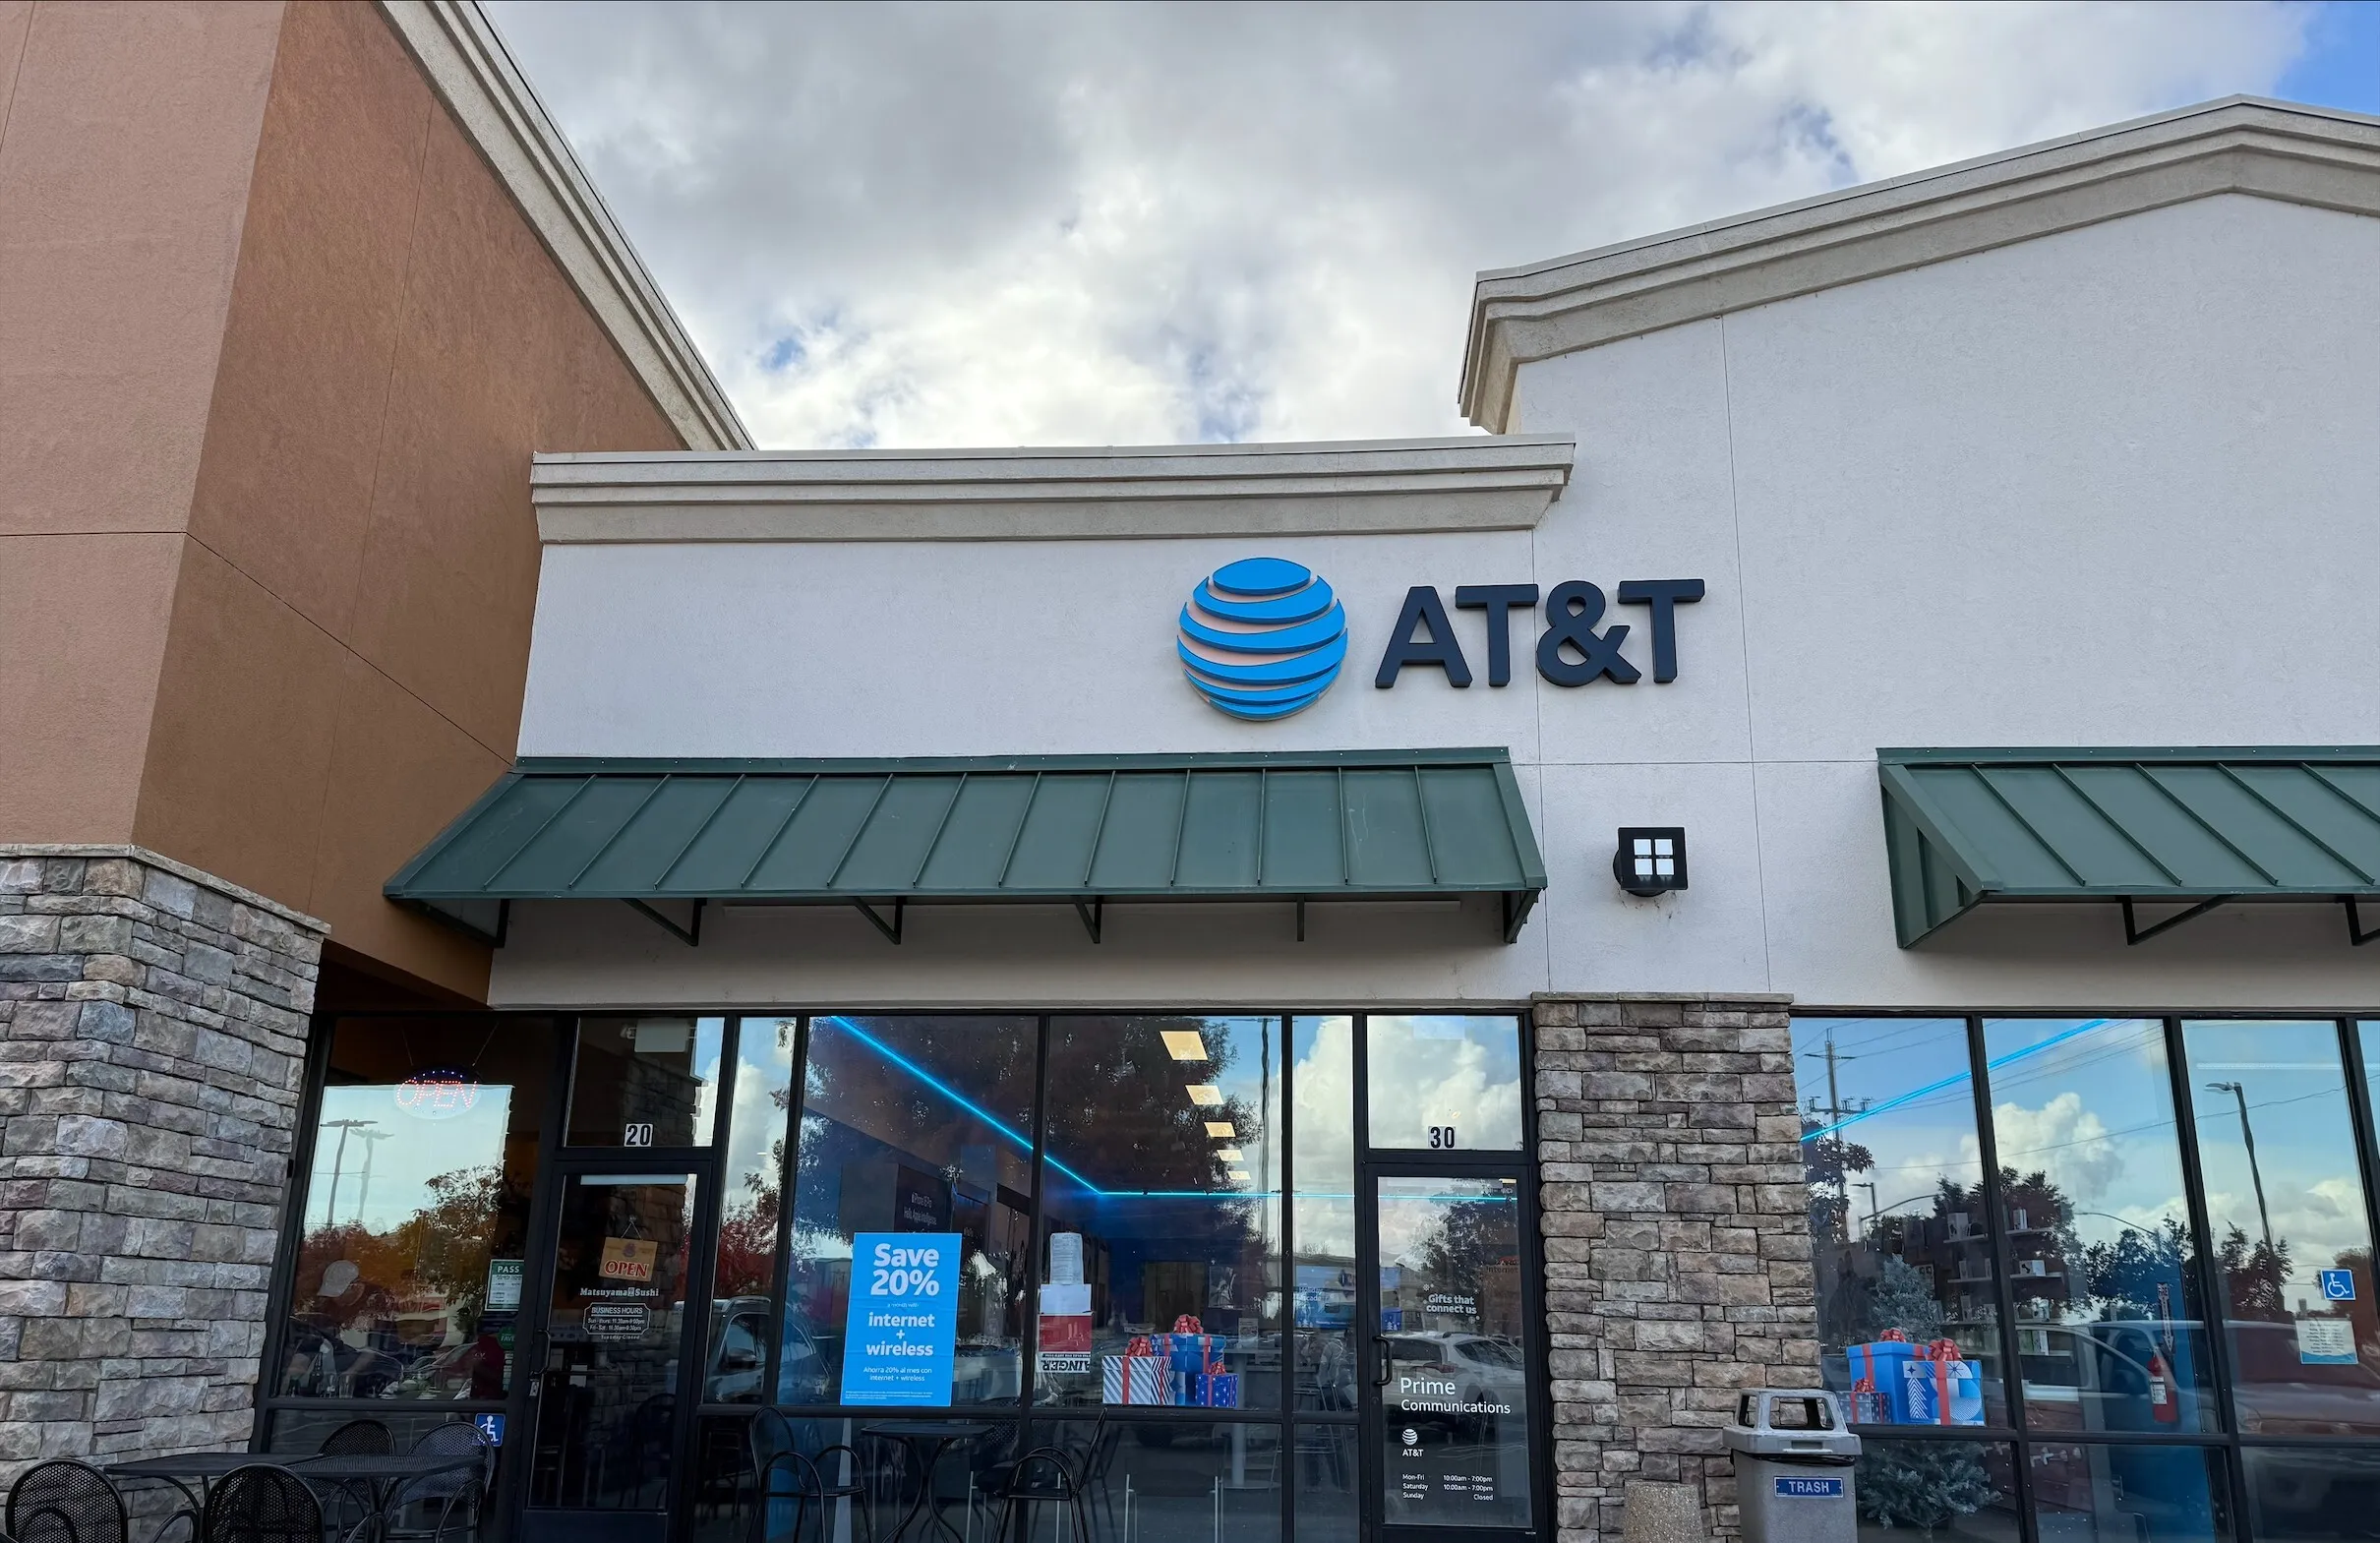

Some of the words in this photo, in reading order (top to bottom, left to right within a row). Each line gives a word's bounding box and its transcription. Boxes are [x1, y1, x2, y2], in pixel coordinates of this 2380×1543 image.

[1375, 579, 1704, 688] AT&T
[396, 1079, 478, 1108] OPEN
[626, 1125, 651, 1146] 20
[1430, 1126, 1455, 1149] 30
[873, 1242, 940, 1268] Save
[604, 1260, 649, 1278] OPEN
[870, 1269, 940, 1296] 20%
[579, 1287, 627, 1298] Matsuyama
[634, 1288, 659, 1297] Sushi
[1428, 1293, 1453, 1304] Gifts
[1454, 1294, 1475, 1305] that
[1426, 1304, 1464, 1314] connect
[1465, 1306, 1477, 1315] us
[868, 1311, 935, 1327] internet
[896, 1329, 906, 1339] +
[865, 1340, 933, 1356] wireless
[1400, 1377, 1456, 1395] Prime
[1400, 1398, 1512, 1414] Communications
[1401, 1449, 1424, 1457] AT&T
[1402, 1482, 1429, 1492] Saturday
[1788, 1481, 1829, 1493] TRASH
[1402, 1491, 1425, 1500] Sunday
